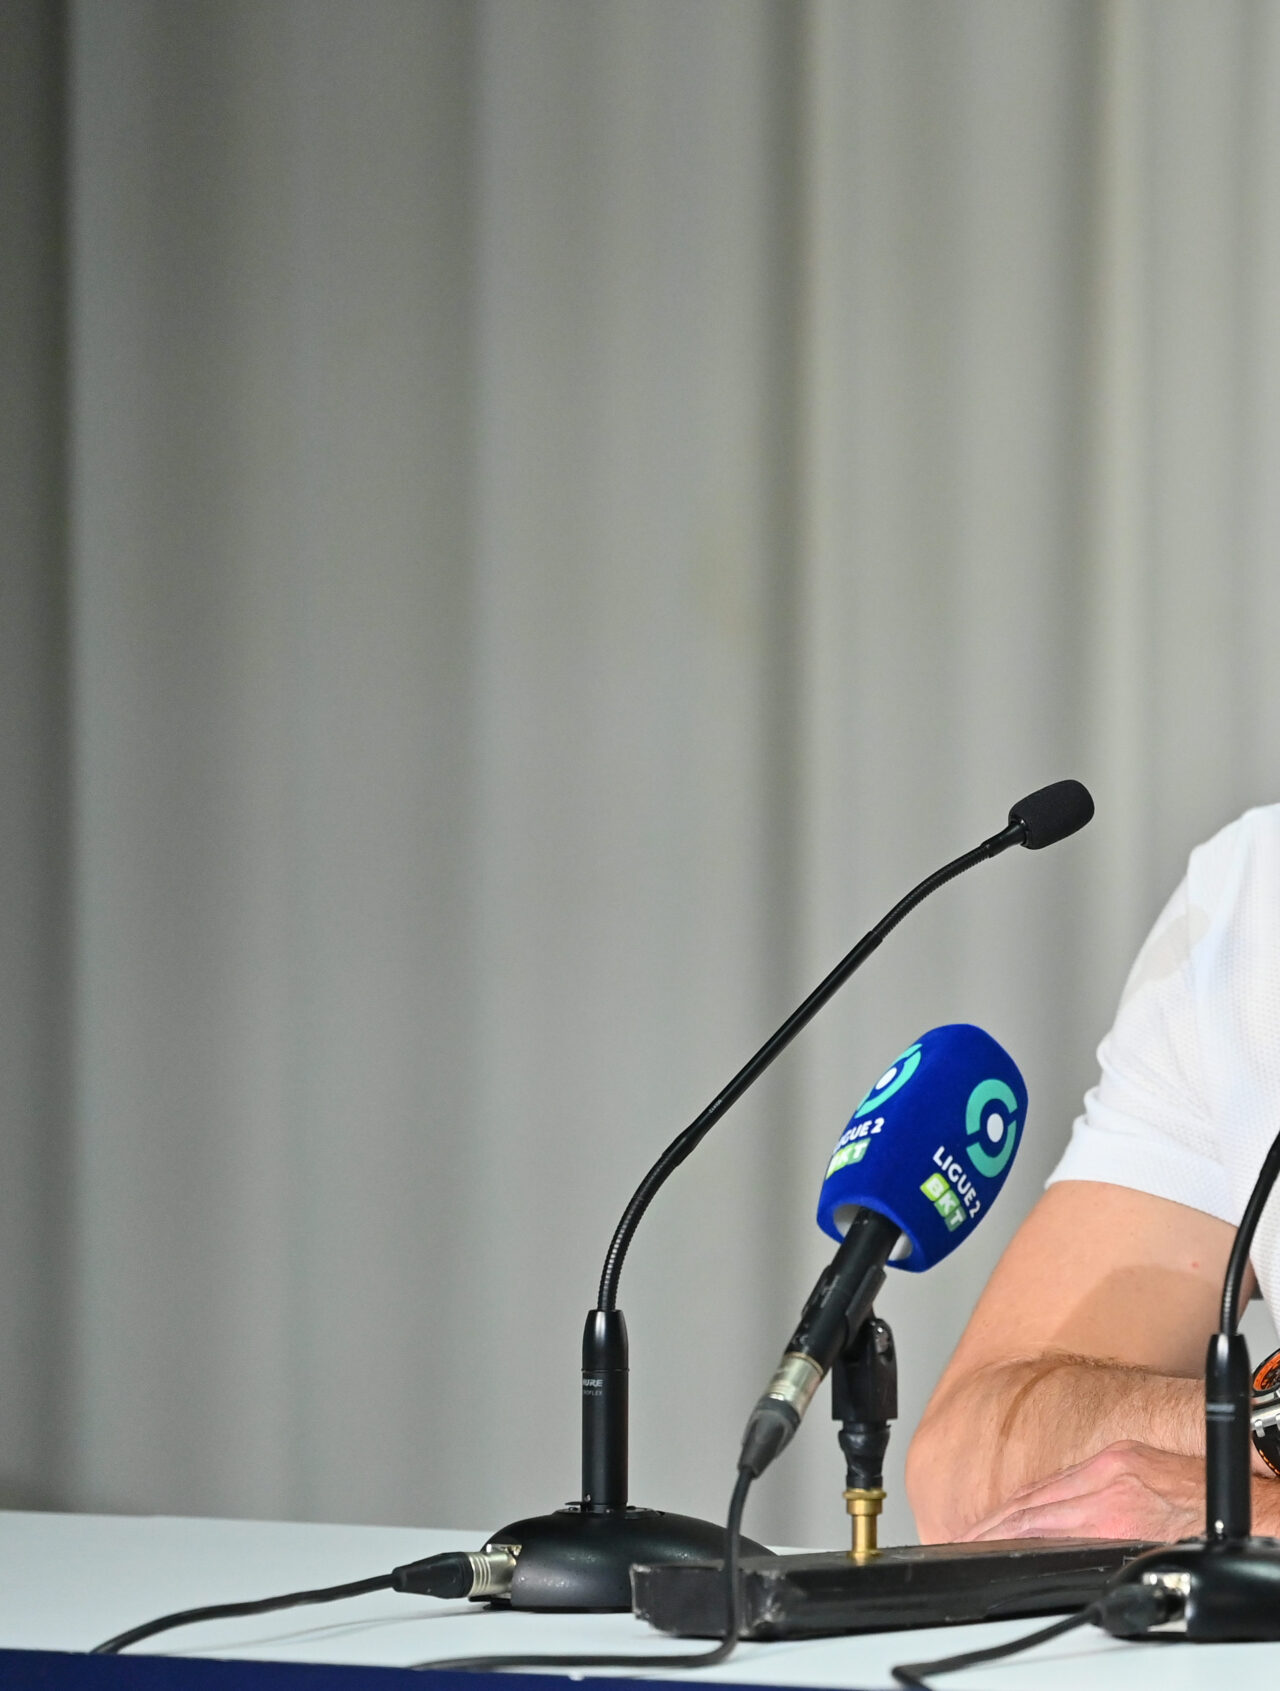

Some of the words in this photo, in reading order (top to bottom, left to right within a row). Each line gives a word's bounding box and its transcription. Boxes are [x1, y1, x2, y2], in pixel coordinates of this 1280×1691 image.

[870, 1117, 885, 1134] 2
[923, 1175, 965, 1228] BKT
[932, 1145, 977, 1207] LIGUE
[968, 1199, 981, 1219] 2
